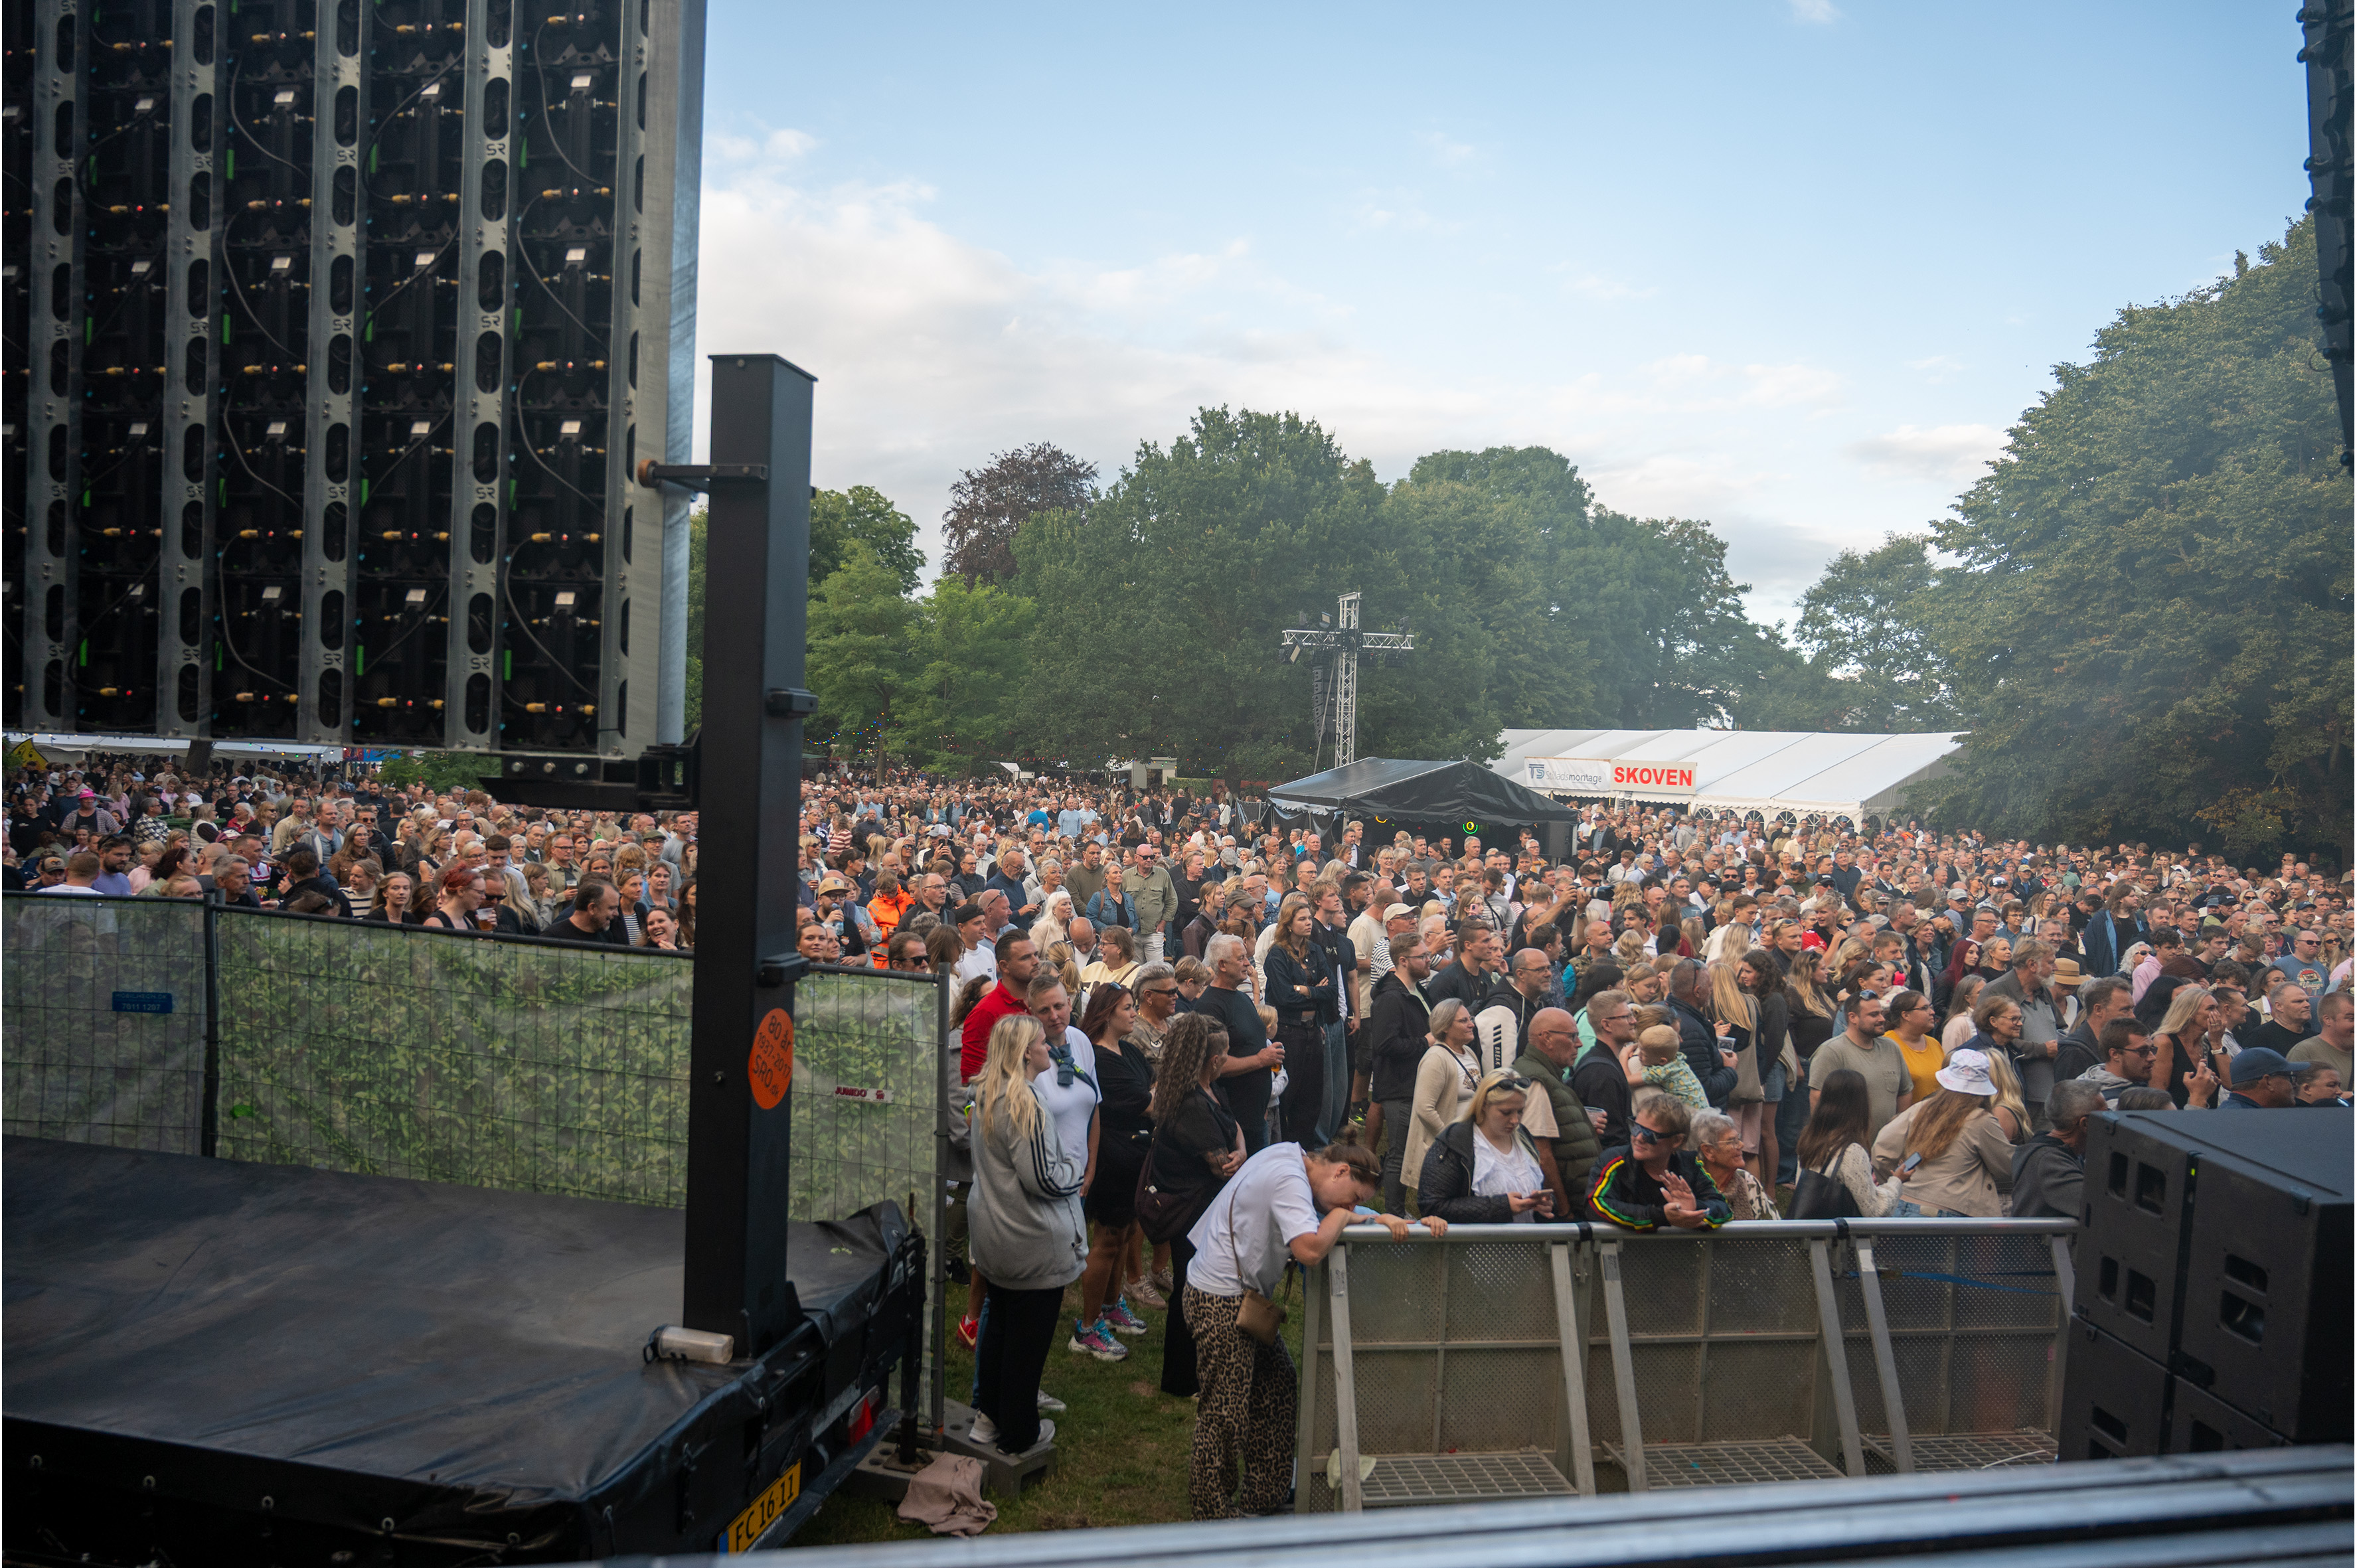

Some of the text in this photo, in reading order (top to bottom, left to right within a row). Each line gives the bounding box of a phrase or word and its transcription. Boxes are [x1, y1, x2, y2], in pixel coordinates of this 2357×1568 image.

[487, 143, 505, 155] SR
[337, 150, 355, 162] SR
[333, 319, 351, 331] SR
[481, 315, 501, 328] SR
[329, 487, 347, 499] SR
[476, 487, 495, 499] SR
[323, 653, 342, 665] SR
[471, 658, 489, 669] SR
[1528, 763, 1544, 779] TS
[1614, 767, 1692, 787] SKOVEN
[768, 1015, 781, 1040] 80
[835, 1086, 867, 1097] JUMBO
[736, 1510, 754, 1551] FC
[760, 1491, 774, 1529] 16
[779, 1473, 794, 1507] 11
